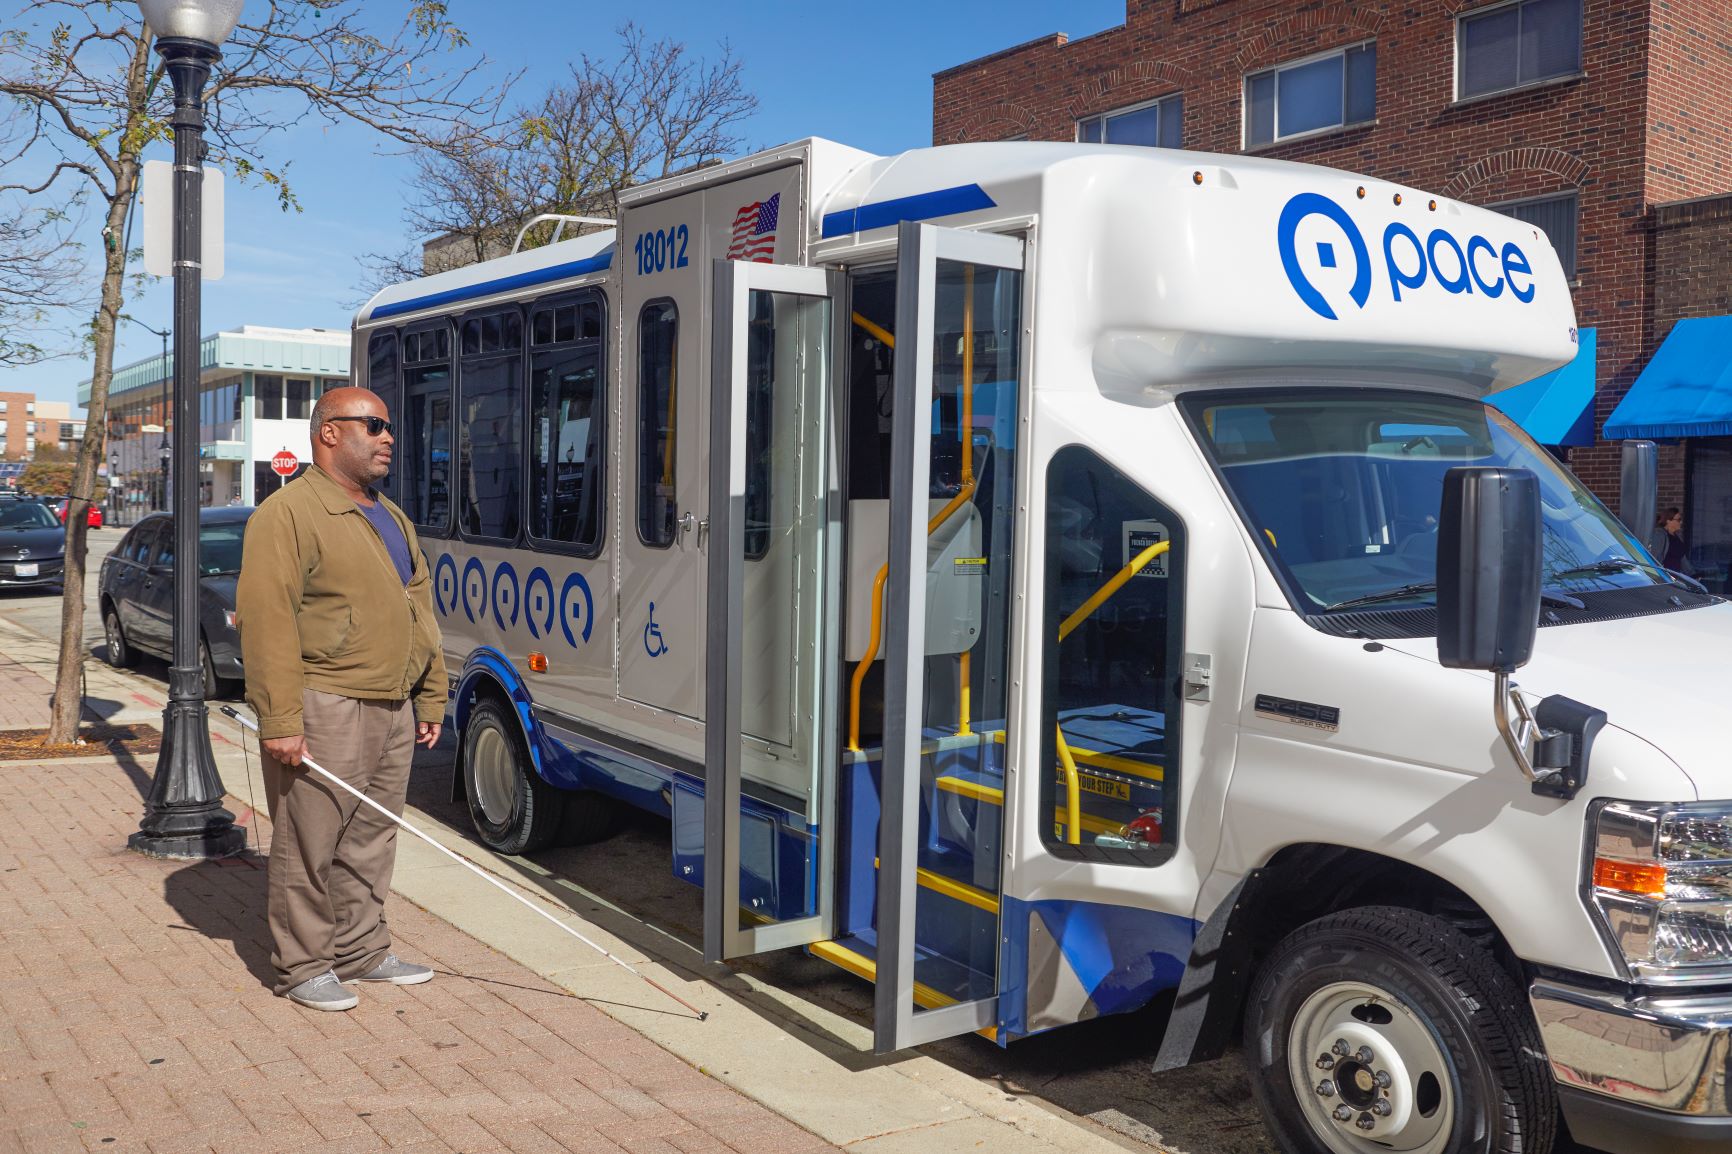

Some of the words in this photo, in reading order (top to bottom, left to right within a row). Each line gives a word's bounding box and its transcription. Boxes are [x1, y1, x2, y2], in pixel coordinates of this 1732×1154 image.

[634, 223, 689, 276] 18012
[1383, 222, 1535, 304] pace
[273, 458, 297, 468] STOP
[1290, 718, 1314, 727] SUPER
[1315, 722, 1336, 731] DUTY
[1078, 774, 1096, 790] YOUR
[1097, 779, 1114, 794] STEP
